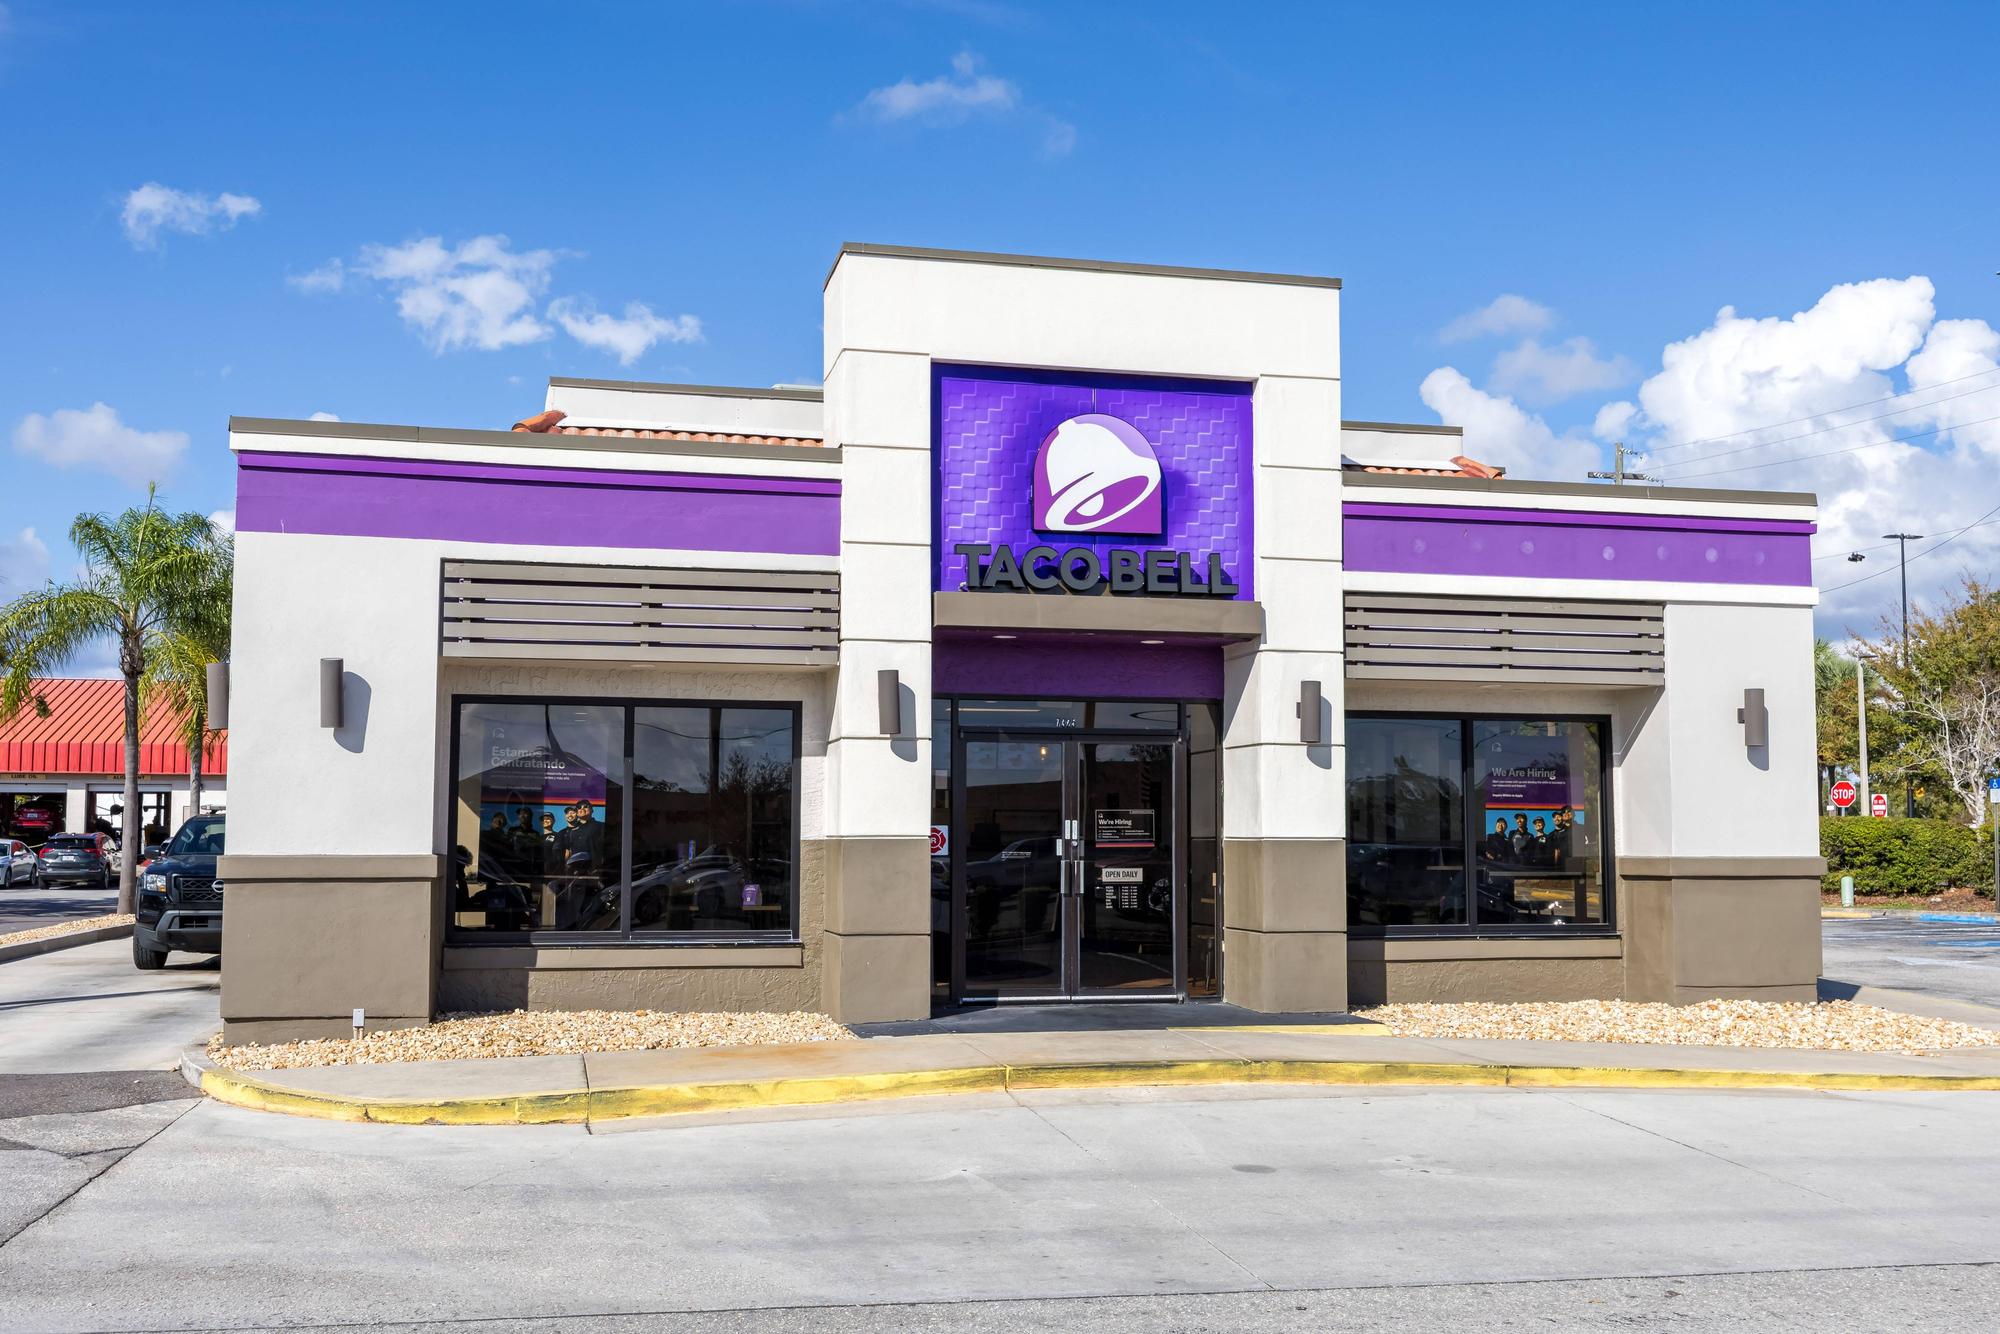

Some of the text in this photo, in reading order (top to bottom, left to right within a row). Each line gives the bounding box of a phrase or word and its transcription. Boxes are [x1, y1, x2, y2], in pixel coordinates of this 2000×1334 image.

[954, 544, 1239, 594] TACO BELL
[492, 746, 543, 757] Estamos
[491, 757, 566, 769] Contratando
[1492, 768, 1556, 780] We Are Hiring
[1833, 789, 1854, 799] STOP
